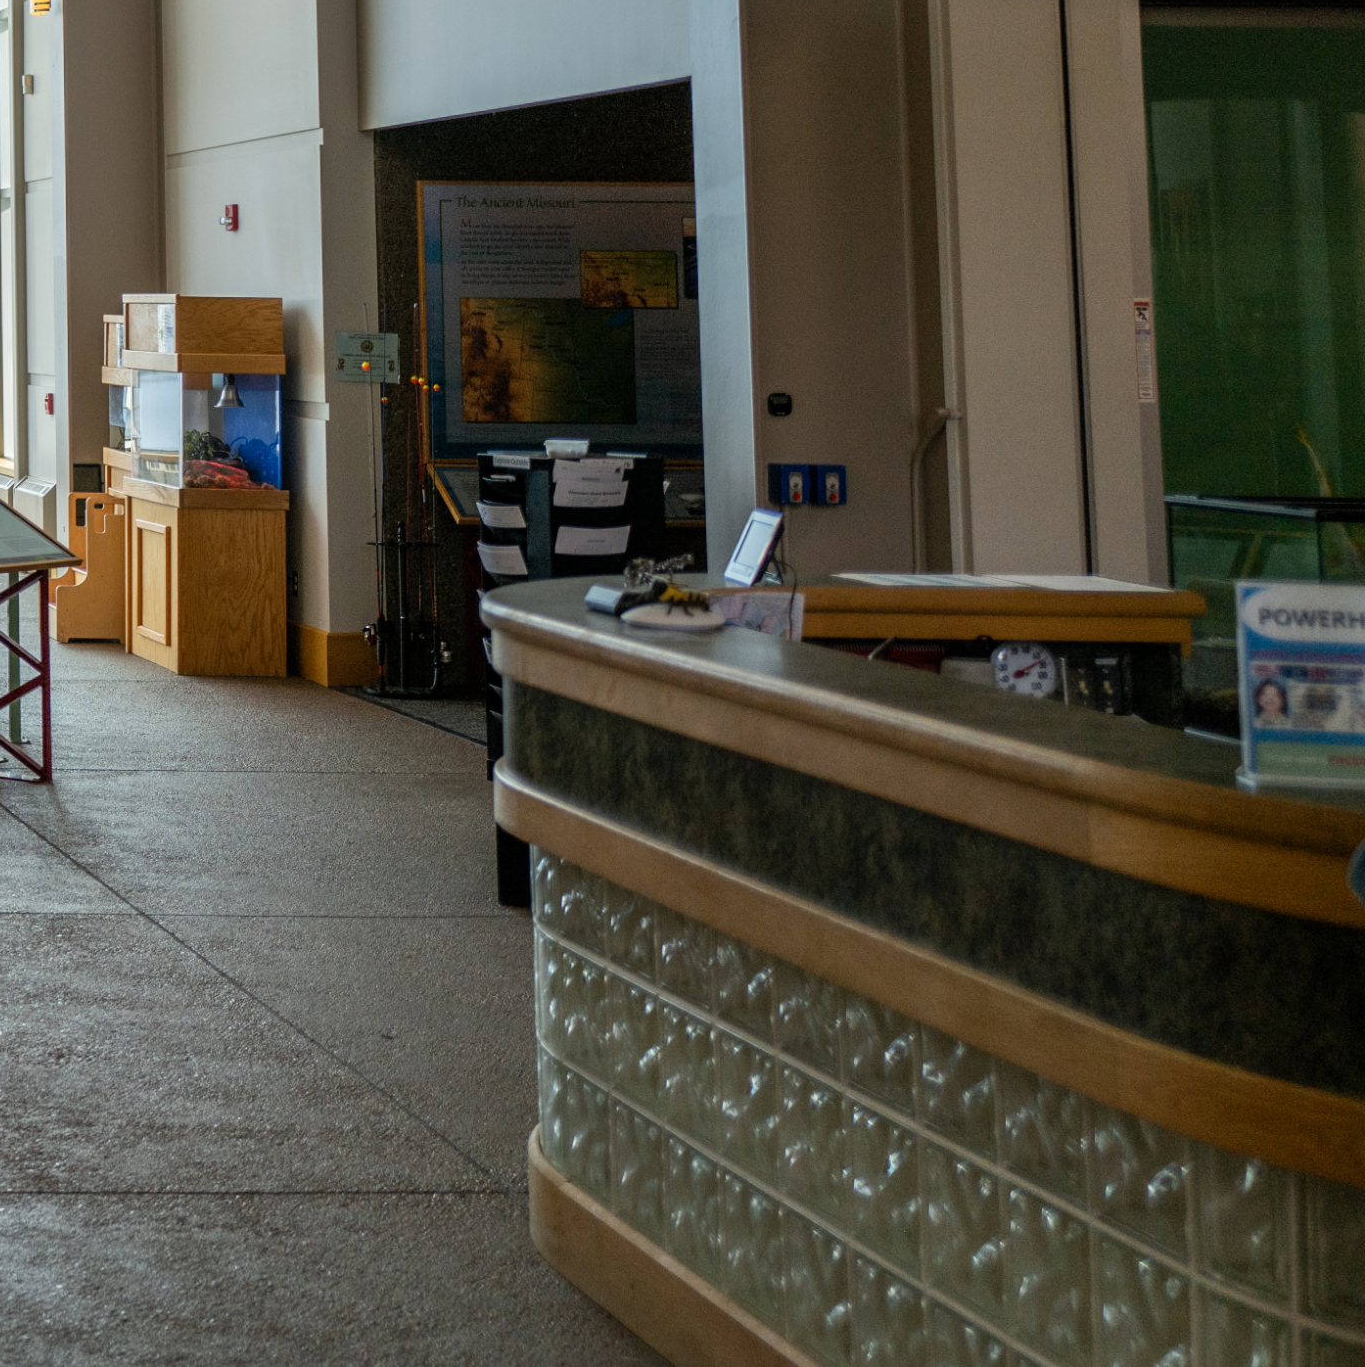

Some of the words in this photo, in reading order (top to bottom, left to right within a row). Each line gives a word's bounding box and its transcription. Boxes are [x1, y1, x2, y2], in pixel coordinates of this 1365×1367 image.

[457, 195, 476, 208] The
[479, 196, 523, 208] Ancient
[526, 197, 576, 208] Missouri
[510, 458, 528, 466] Outside
[1258, 607, 1365, 629] POWERH
